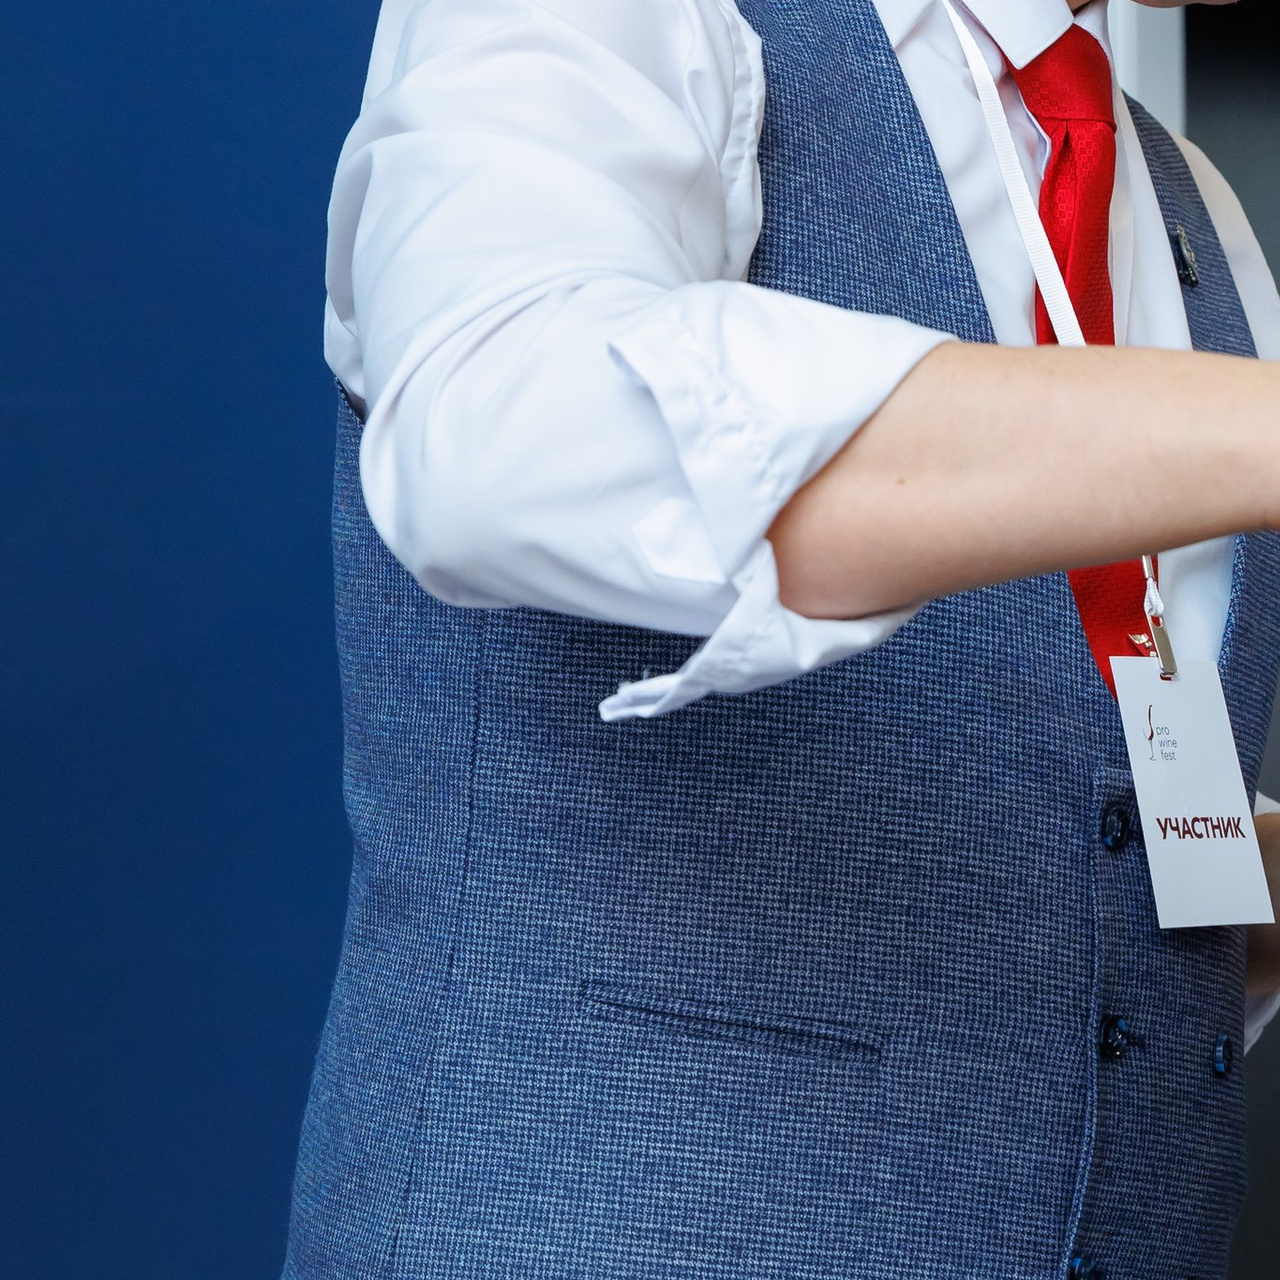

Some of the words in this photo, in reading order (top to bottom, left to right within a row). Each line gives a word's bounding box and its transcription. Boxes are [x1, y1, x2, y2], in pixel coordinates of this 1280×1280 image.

[1155, 726, 1170, 737] pro
[1158, 738, 1177, 748] wine
[1160, 749, 1177, 761] fest
[1156, 816, 1246, 840] УЧАСТНИК
